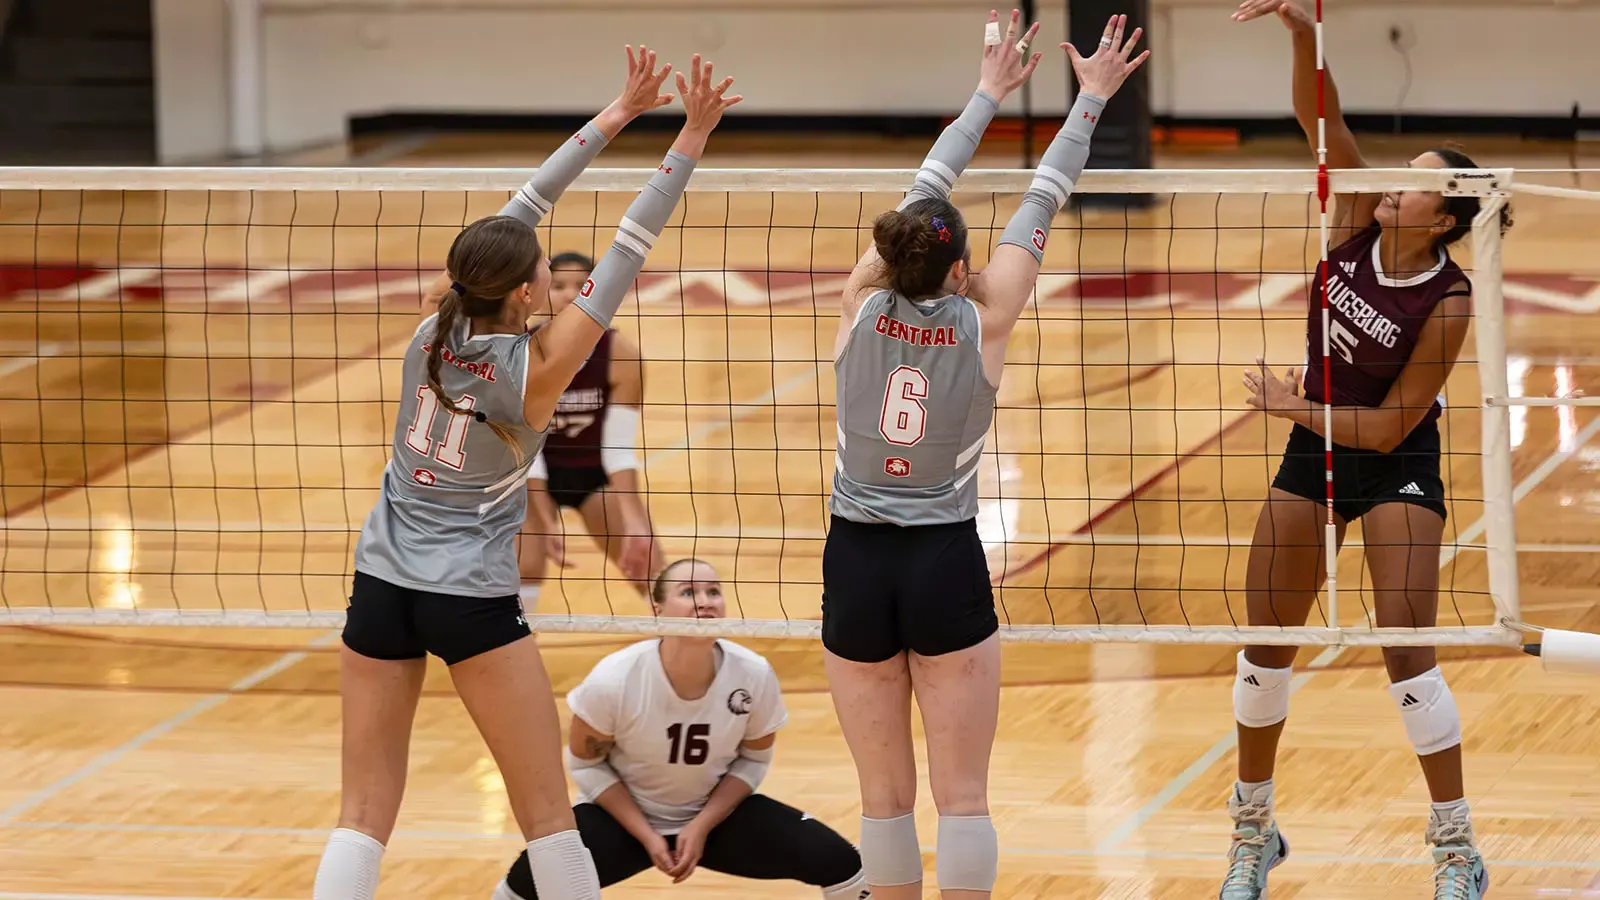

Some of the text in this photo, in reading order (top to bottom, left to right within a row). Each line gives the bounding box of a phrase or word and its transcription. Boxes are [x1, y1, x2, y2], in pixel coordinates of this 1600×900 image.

[875, 313, 958, 346] CENTRAL
[1329, 318, 1360, 365] 5
[421, 344, 497, 383] NTRAL
[405, 384, 476, 472] 11
[879, 365, 930, 448] 6
[667, 723, 710, 765] 16
